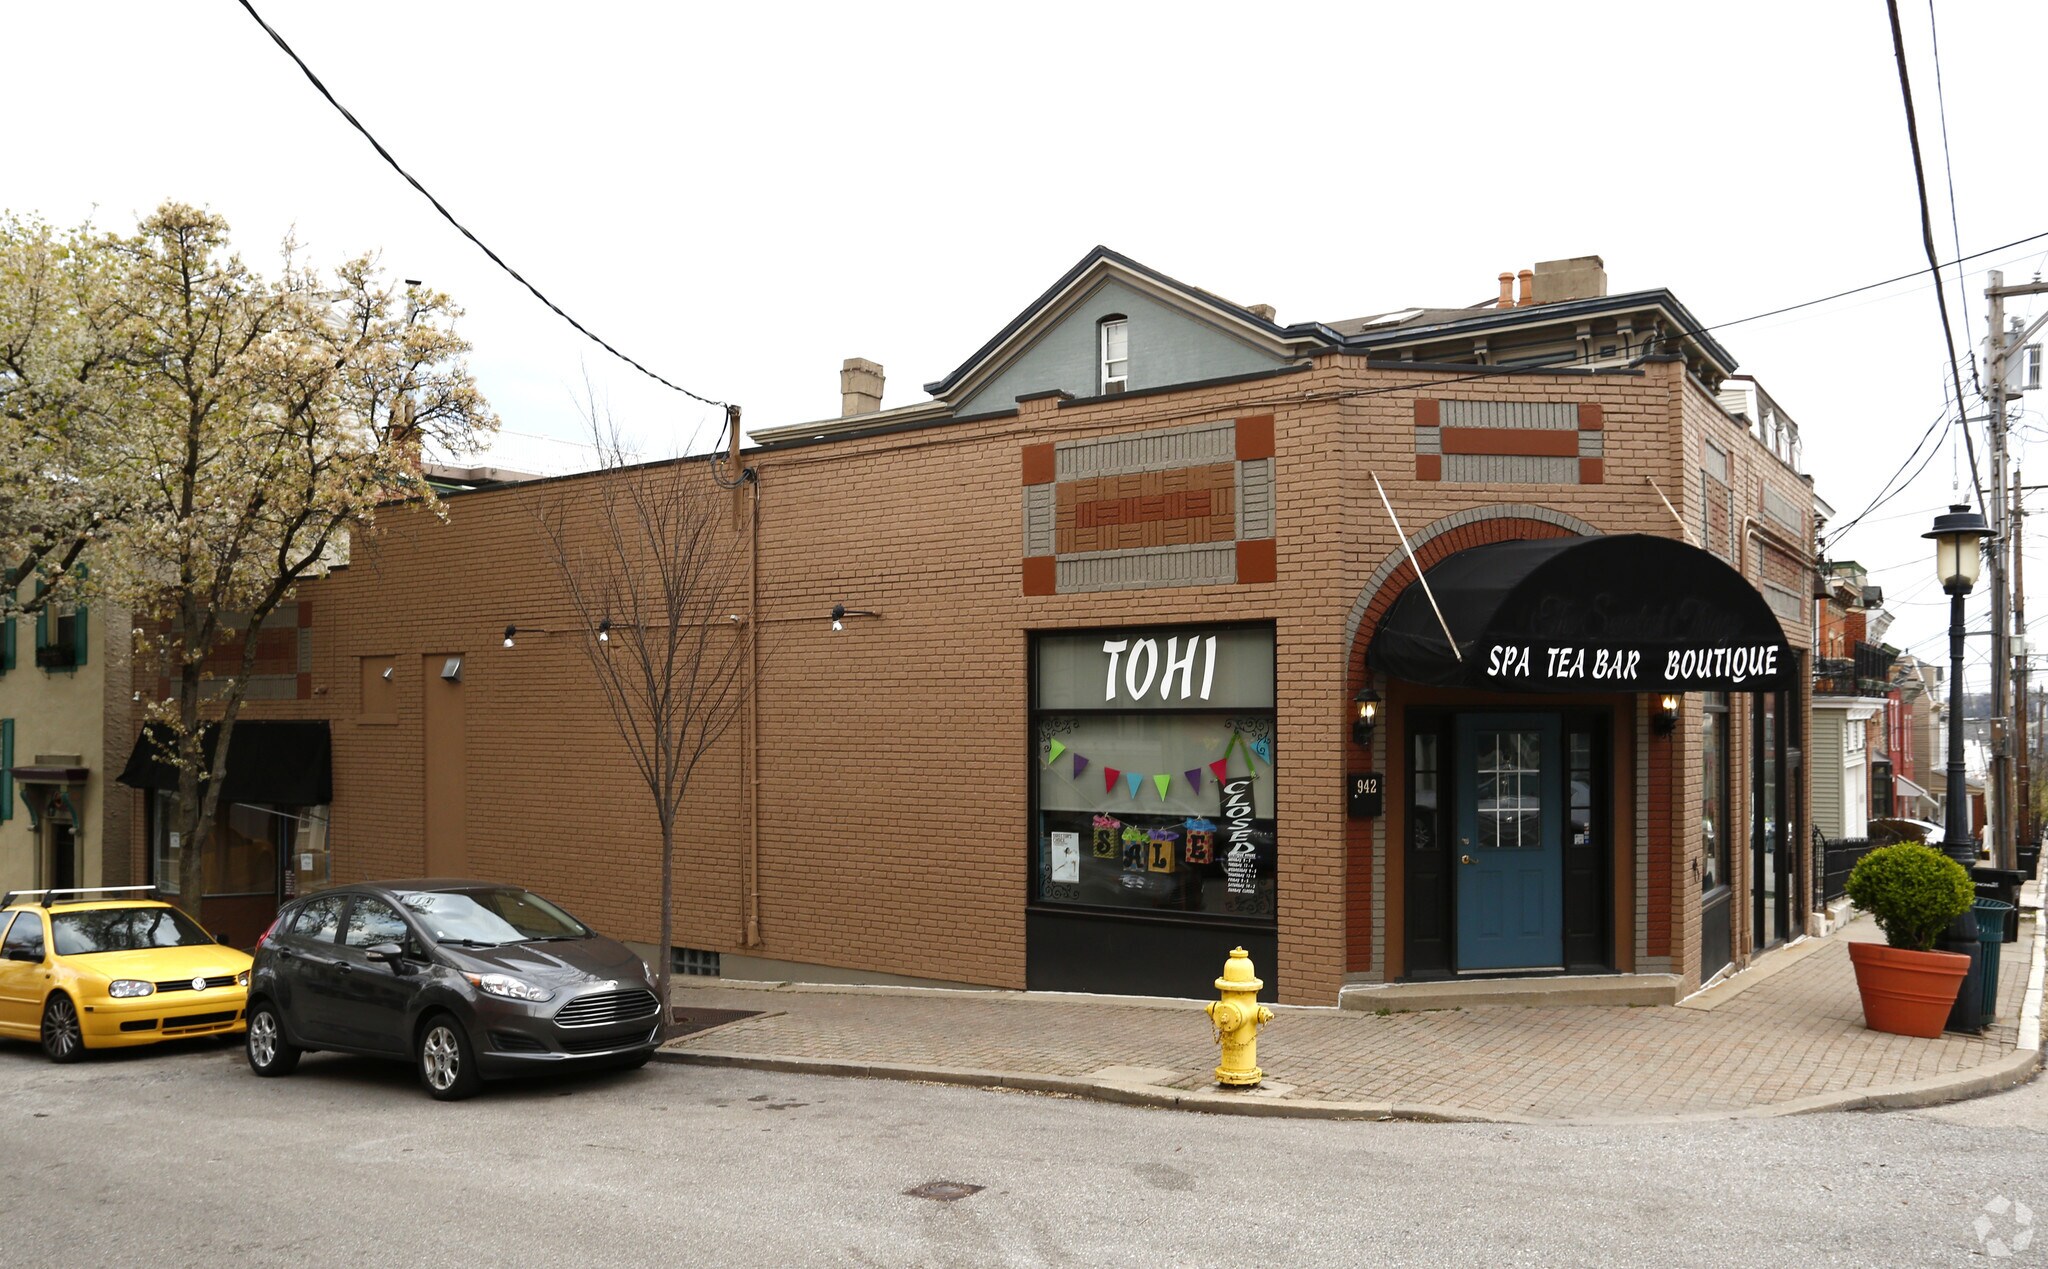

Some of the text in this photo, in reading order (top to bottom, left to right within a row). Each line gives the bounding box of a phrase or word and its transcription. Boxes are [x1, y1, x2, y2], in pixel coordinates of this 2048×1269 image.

[1103, 636, 1216, 701] TOHI
[1487, 645, 1779, 683] SPA TEA BAR BOUTIQUE
[1357, 779, 1377, 794] 942
[1223, 781, 1255, 856] CLOSED
[1097, 829, 1206, 868] SALE
